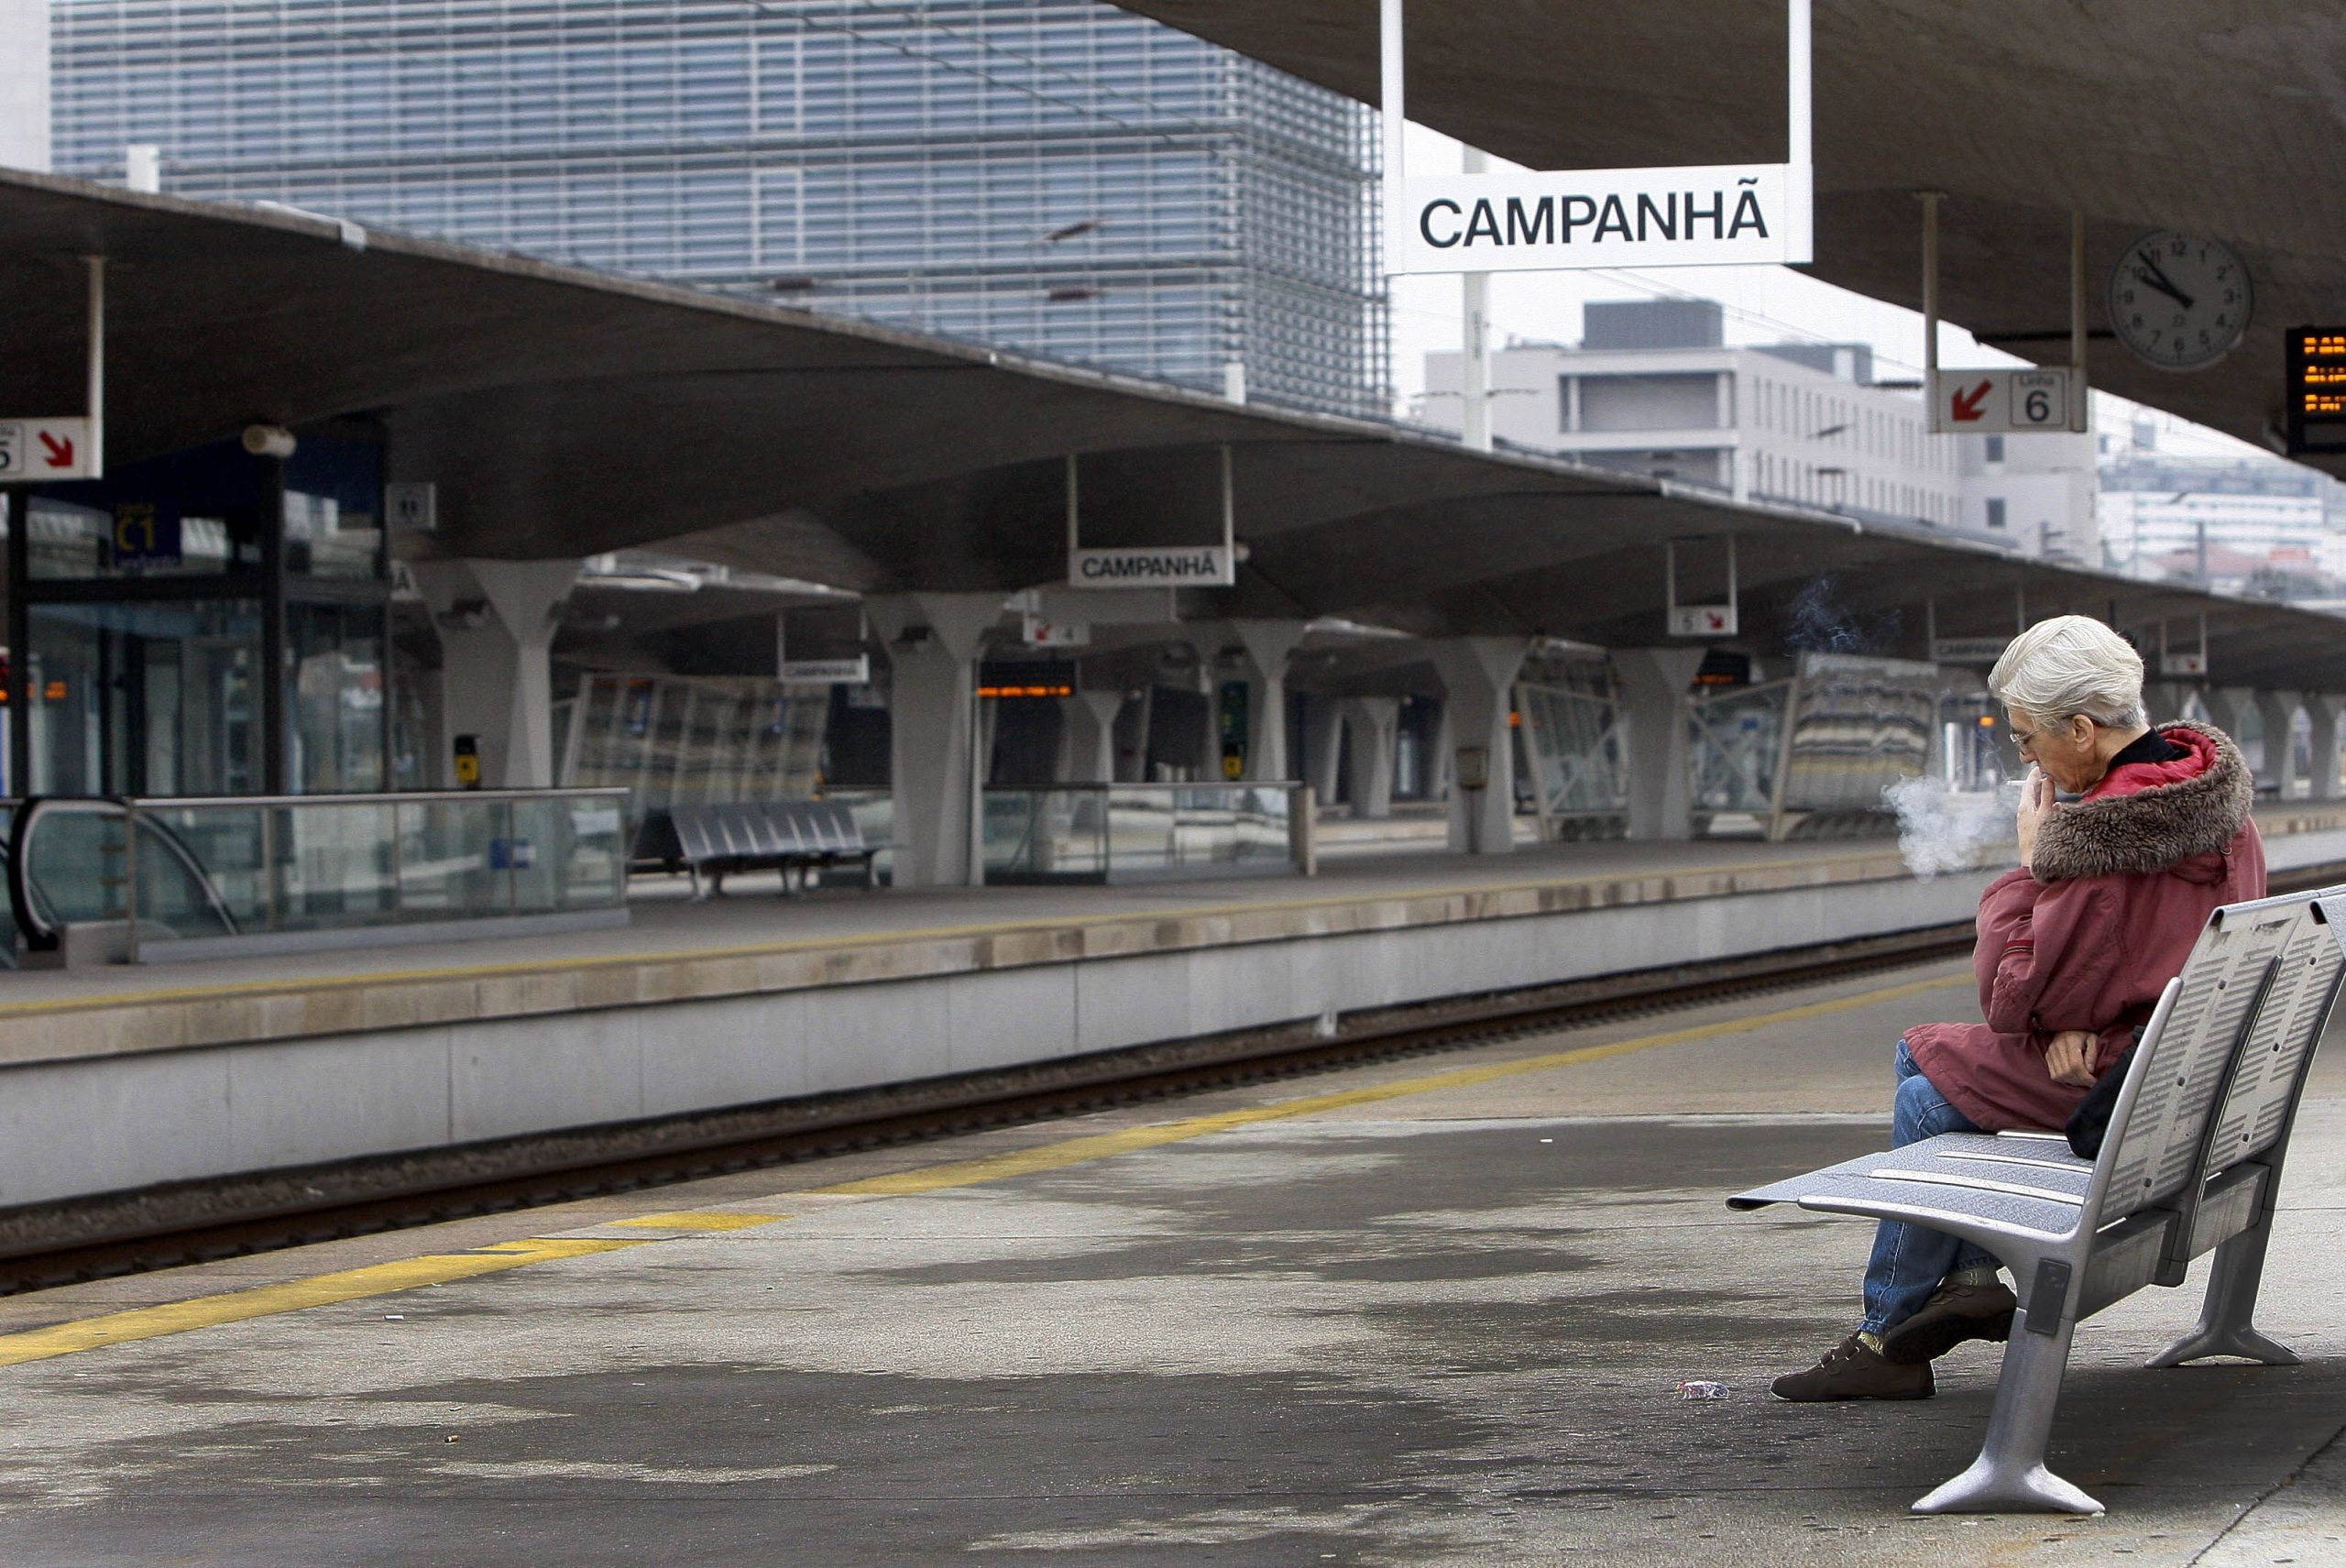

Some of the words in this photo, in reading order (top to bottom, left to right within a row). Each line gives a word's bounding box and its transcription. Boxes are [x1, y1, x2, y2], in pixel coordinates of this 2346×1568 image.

[1420, 177, 1769, 248] CAMPANHÃ
[2025, 390, 2050, 422] 6
[1081, 550, 1217, 578] CAMPANHÃ
